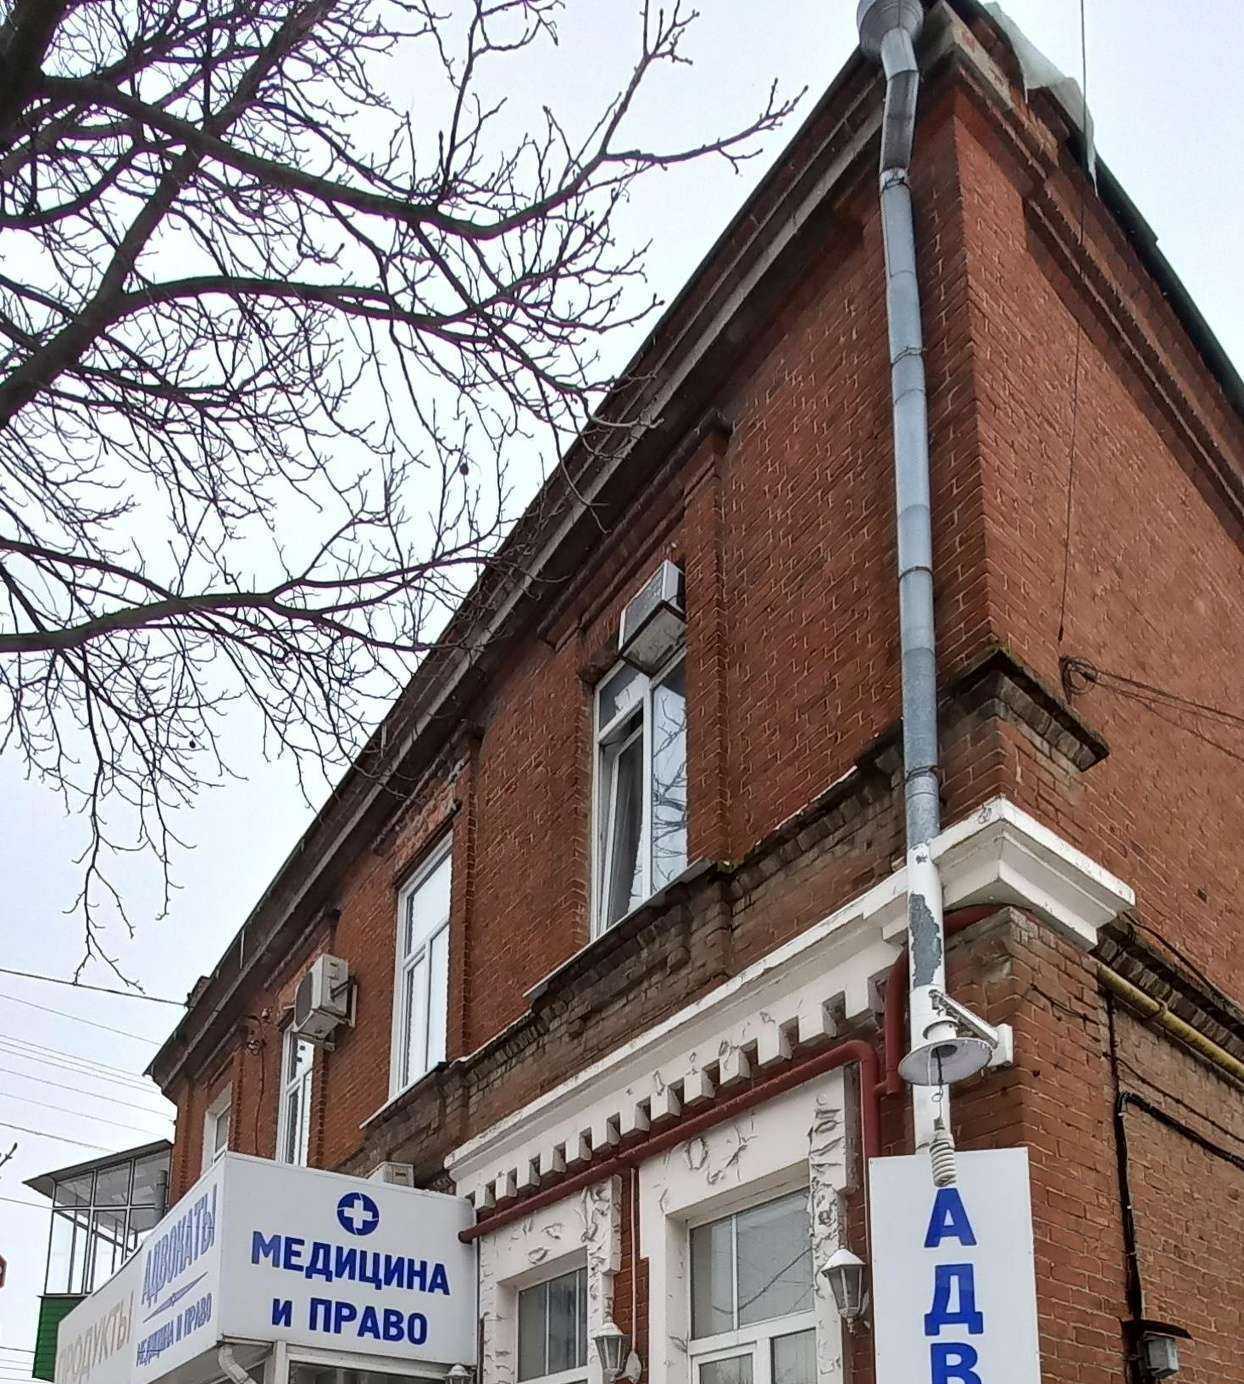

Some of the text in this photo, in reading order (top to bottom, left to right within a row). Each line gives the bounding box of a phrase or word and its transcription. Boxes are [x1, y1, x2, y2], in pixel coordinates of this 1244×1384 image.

[141, 1183, 217, 1308] АДВОКАТЫ
[251, 1231, 450, 1295] МЕДИЦИНА
[184, 1293, 213, 1337] ПРАВО
[309, 1297, 428, 1345] ПРАВО
